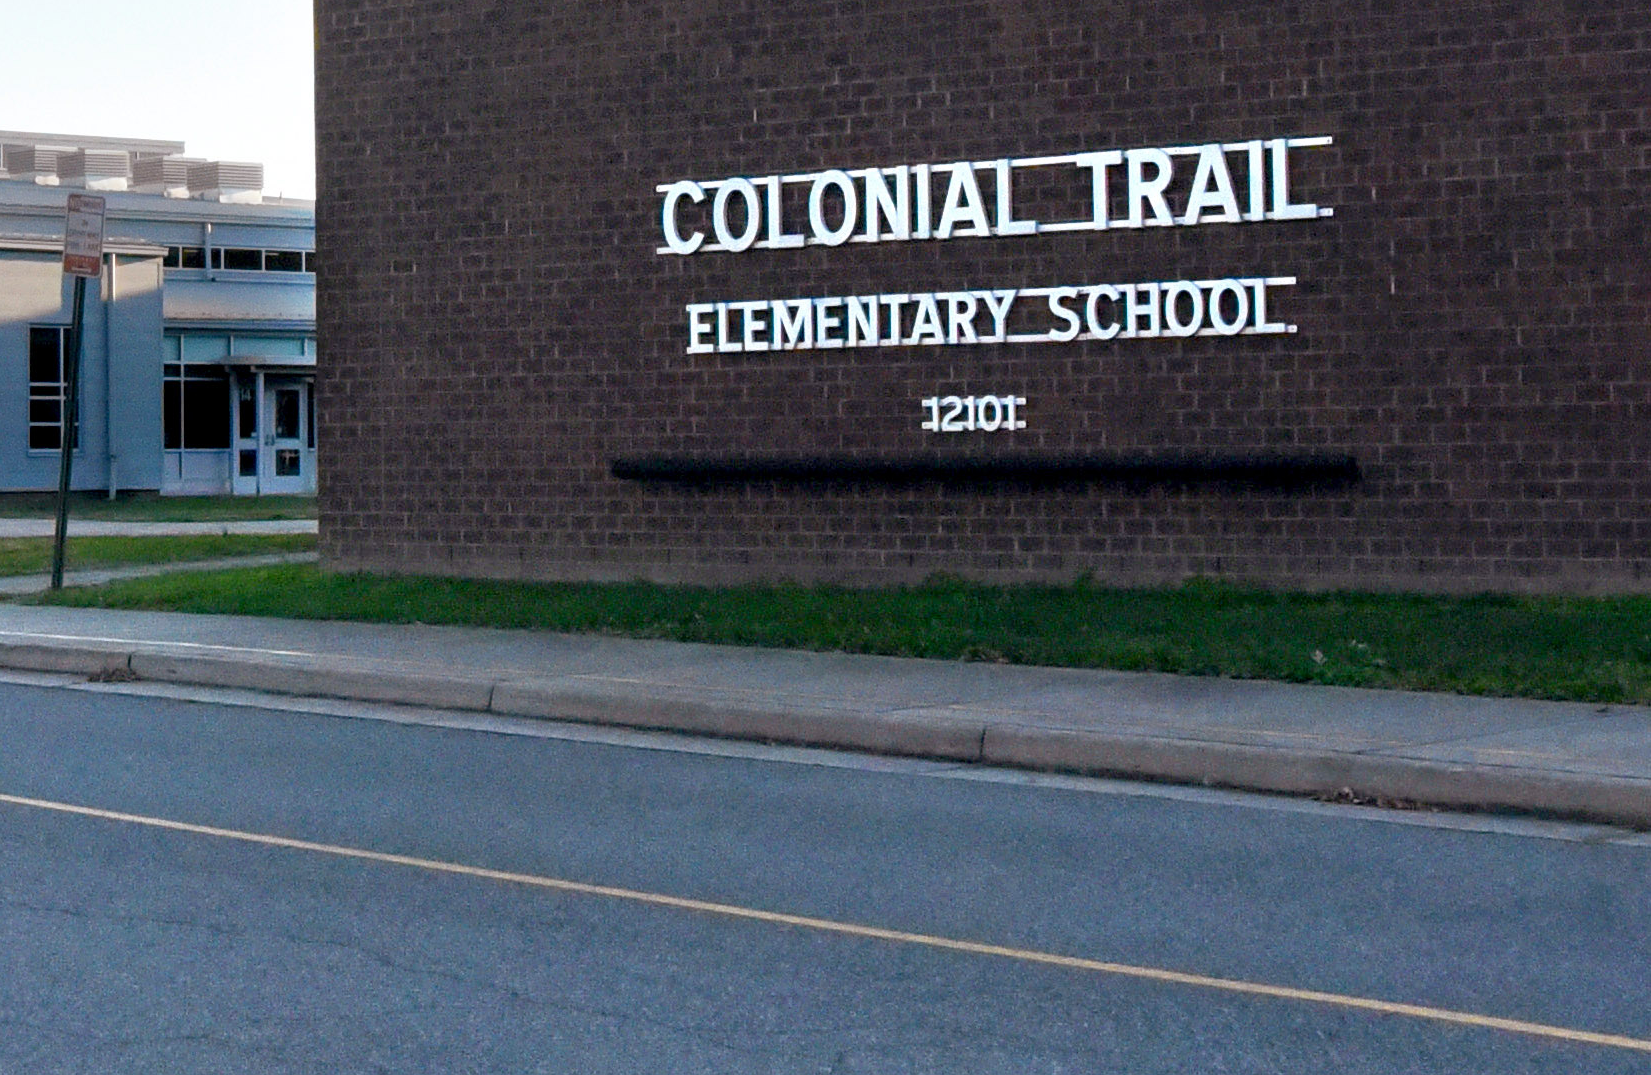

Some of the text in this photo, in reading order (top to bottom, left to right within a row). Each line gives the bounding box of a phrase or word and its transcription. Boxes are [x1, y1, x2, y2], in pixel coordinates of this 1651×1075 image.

[661, 138, 1317, 255] COLONIAL TRAIL
[687, 278, 1286, 353] ELEMENTARY SCHOOL
[926, 395, 1016, 432] 12101
